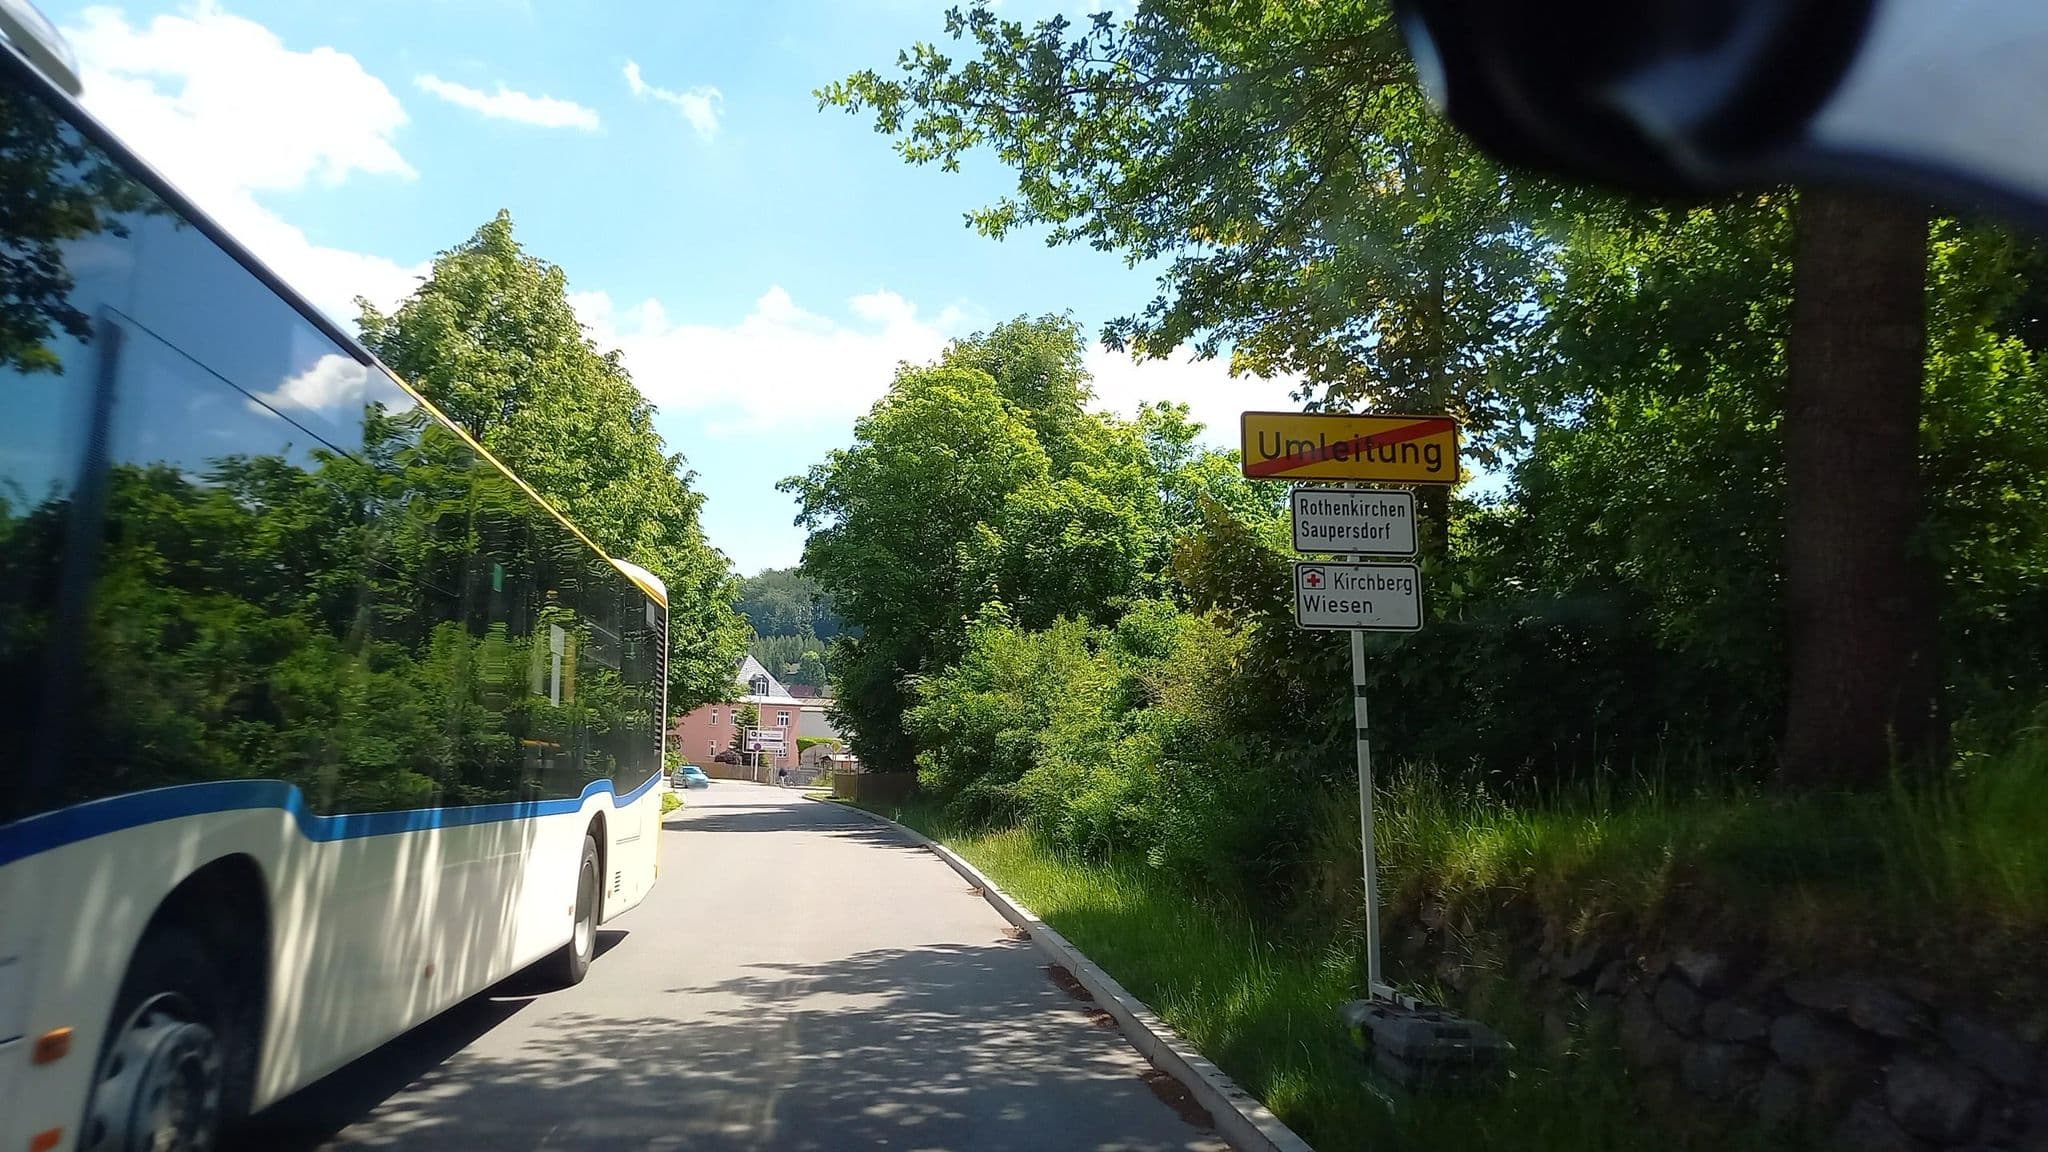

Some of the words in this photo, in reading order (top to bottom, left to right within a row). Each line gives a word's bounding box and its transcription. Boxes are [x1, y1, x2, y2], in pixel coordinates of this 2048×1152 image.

[1257, 431, 1442, 473] Umleitung
[1300, 498, 1406, 518] Rothenkirchen
[1301, 520, 1390, 542] Saupersdorf
[1334, 572, 1413, 595] Kirchberg
[1303, 595, 1373, 614] Wiesen
